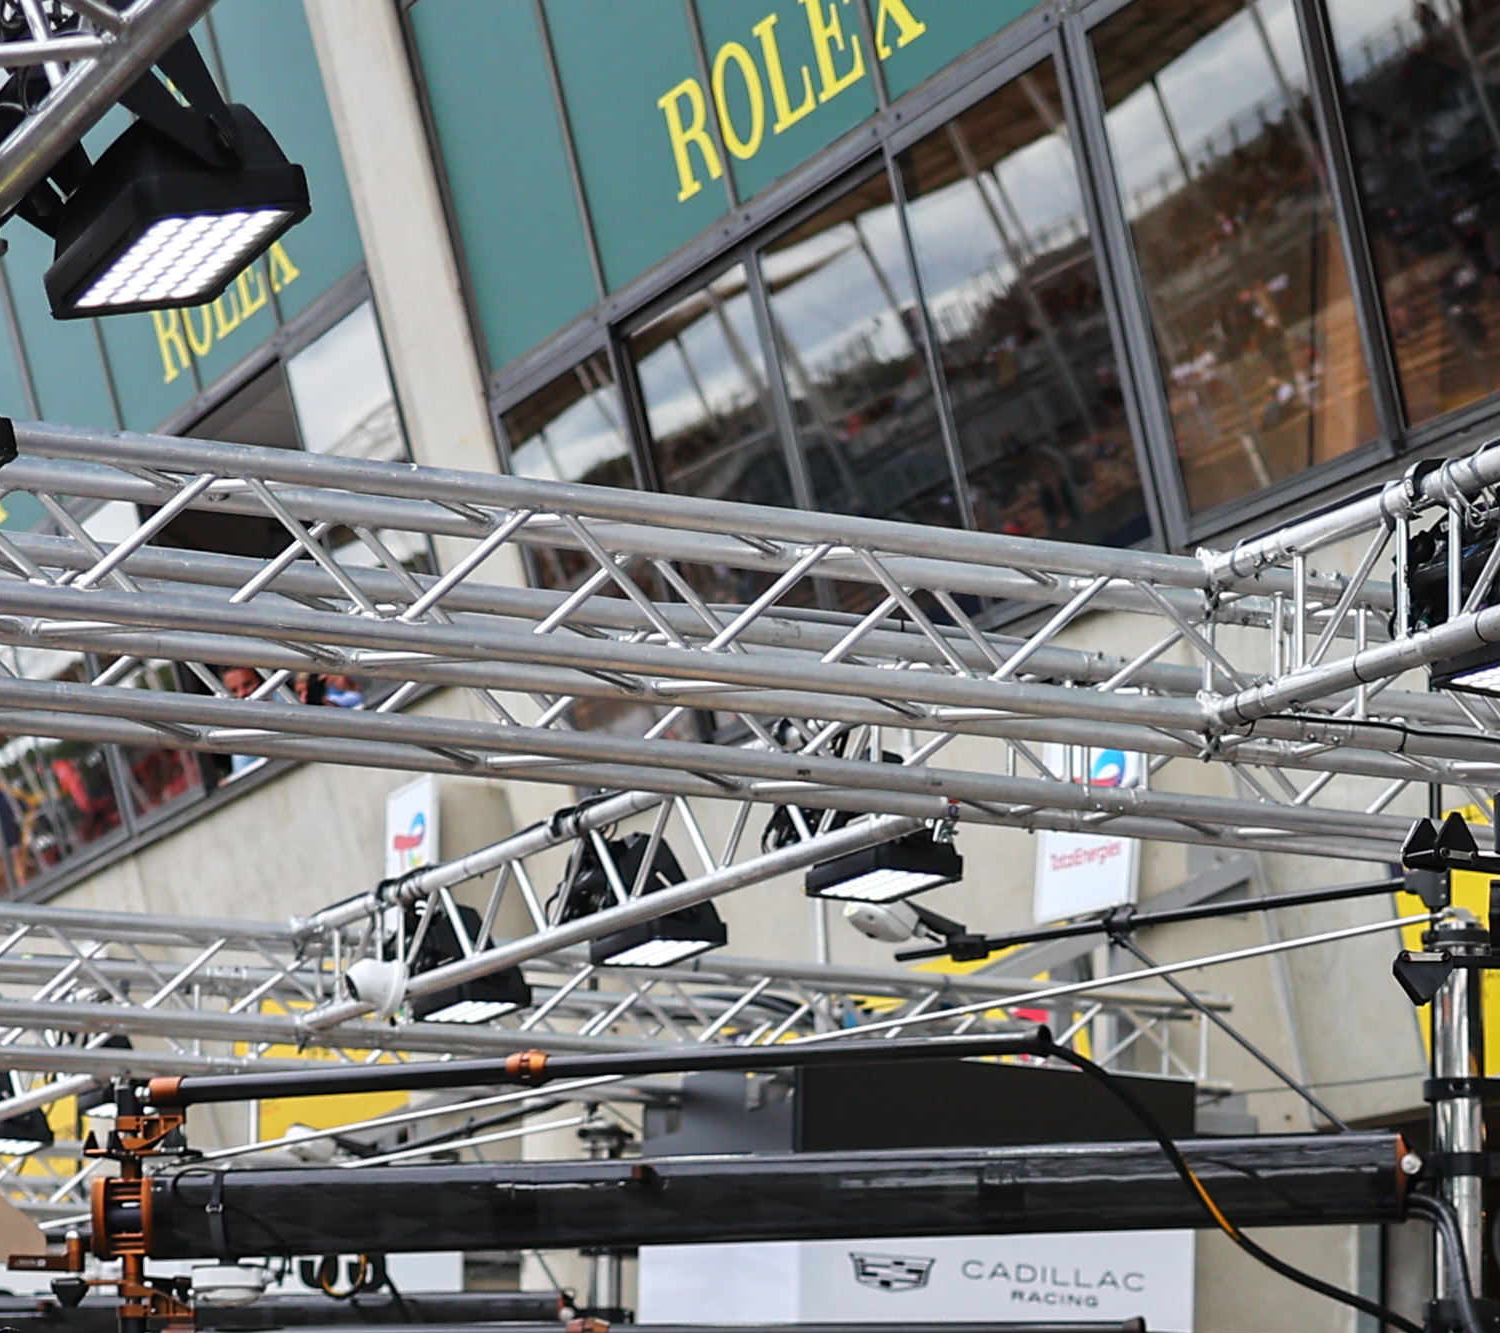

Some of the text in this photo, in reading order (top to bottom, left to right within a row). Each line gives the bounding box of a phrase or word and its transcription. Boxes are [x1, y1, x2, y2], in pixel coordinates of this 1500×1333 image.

[656, 0, 927, 202] ROLEX
[960, 1257, 1146, 1294] CADILLAC
[1010, 1289, 1100, 1308] RACING
